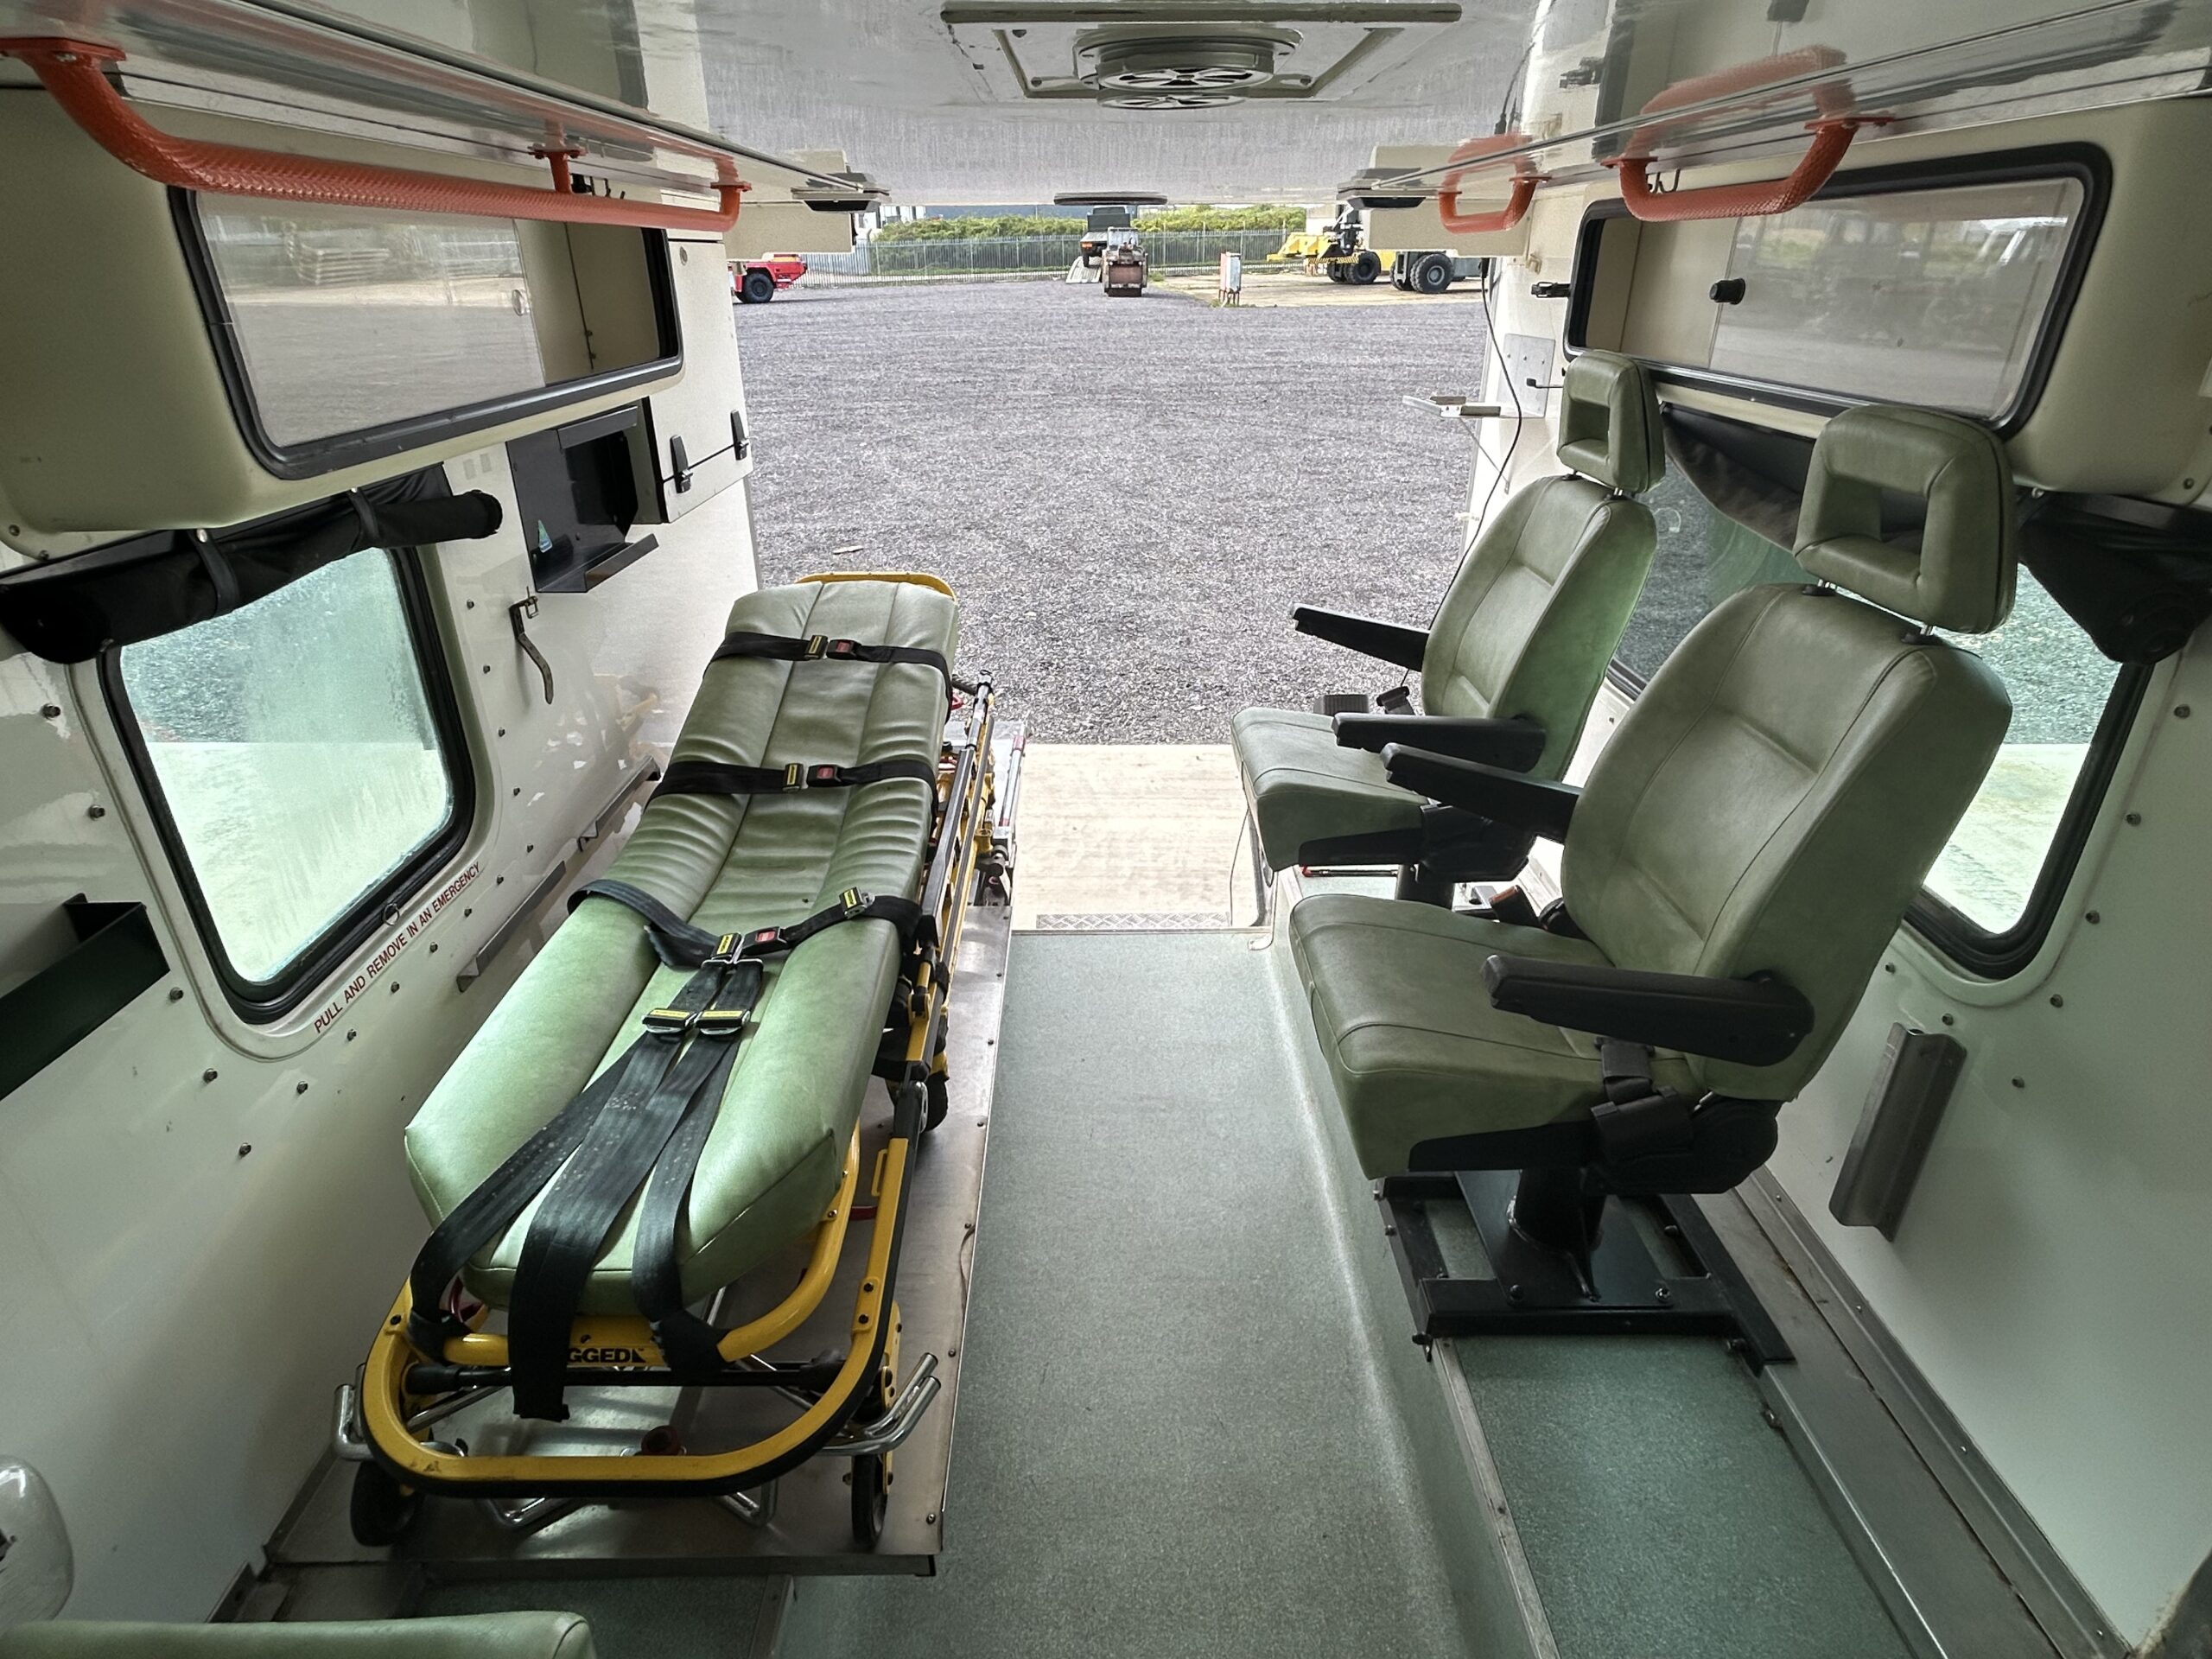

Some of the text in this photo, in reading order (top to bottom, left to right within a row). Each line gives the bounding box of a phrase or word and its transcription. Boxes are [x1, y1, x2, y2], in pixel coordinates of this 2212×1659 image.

[314, 861, 480, 1033] PULL AND REMOVE IN AN EMERGENCY
[569, 1348, 631, 1363] GGED
